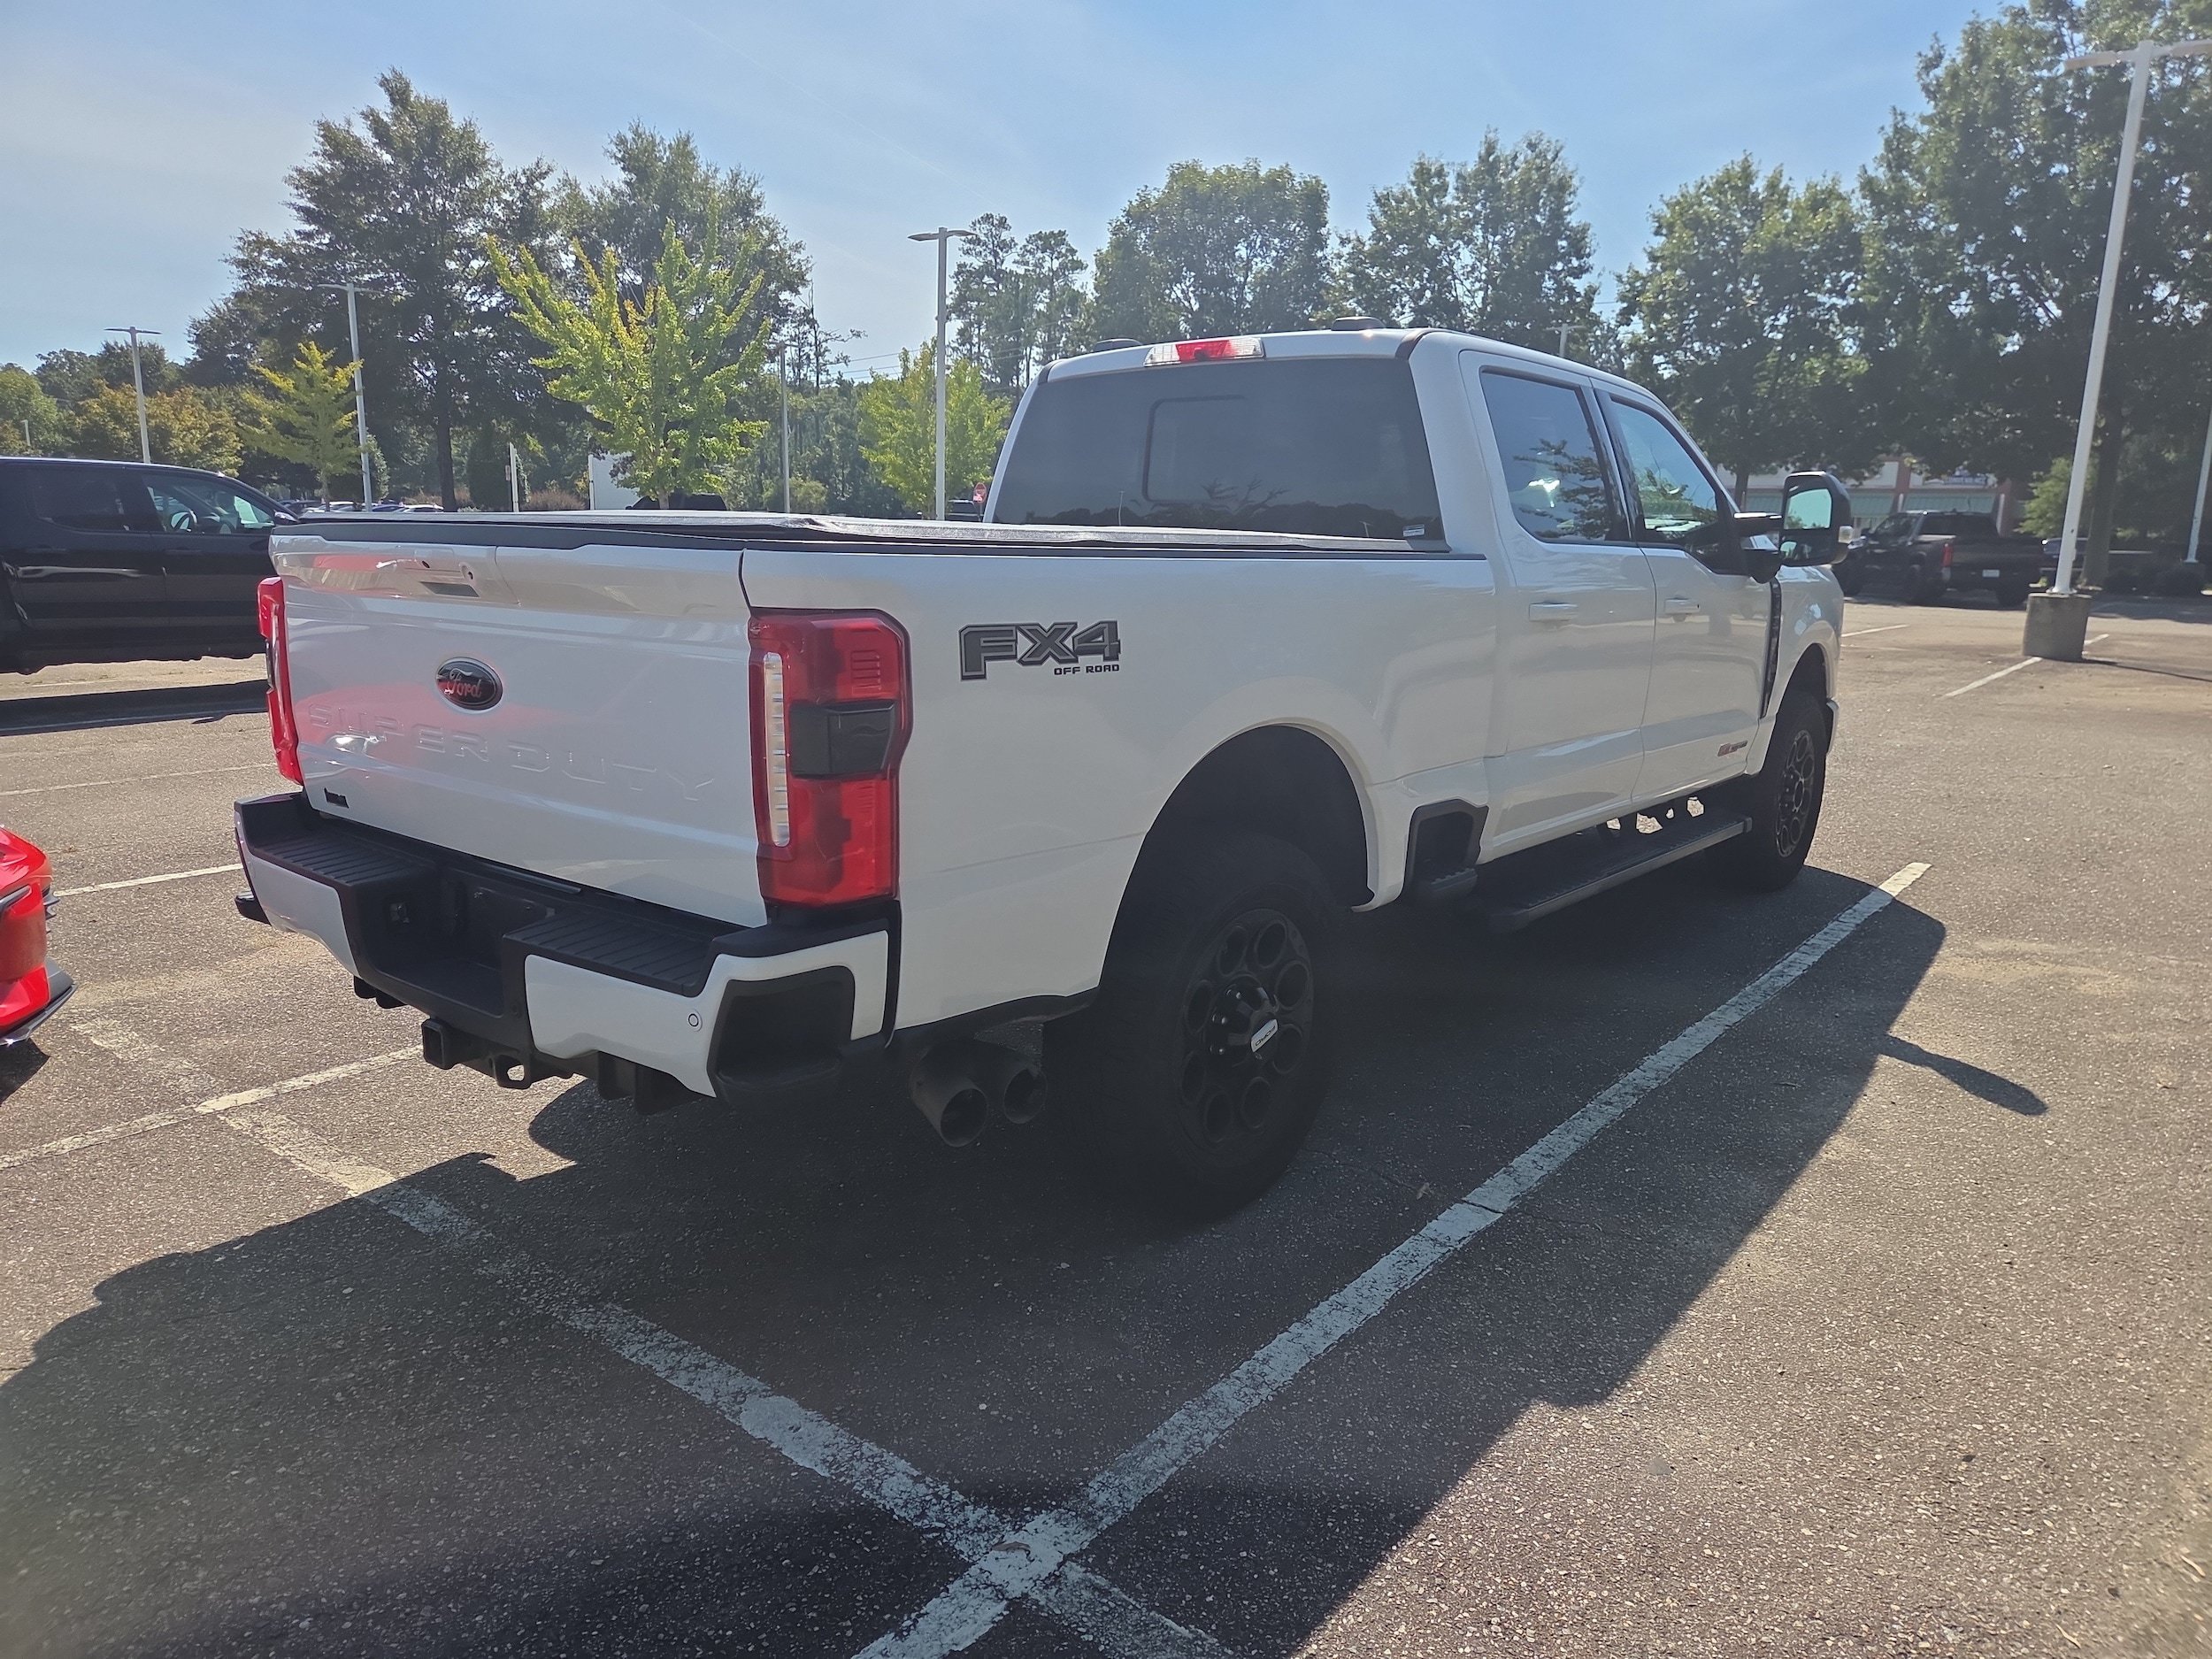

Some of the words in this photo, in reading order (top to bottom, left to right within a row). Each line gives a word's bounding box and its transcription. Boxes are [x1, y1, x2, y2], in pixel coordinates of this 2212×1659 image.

[959, 620, 1121, 680] FX4
[1054, 667, 1081, 676] OFF
[1086, 664, 1120, 674] ROAD
[444, 667, 482, 698] Ford
[506, 740, 714, 802] DUTY
